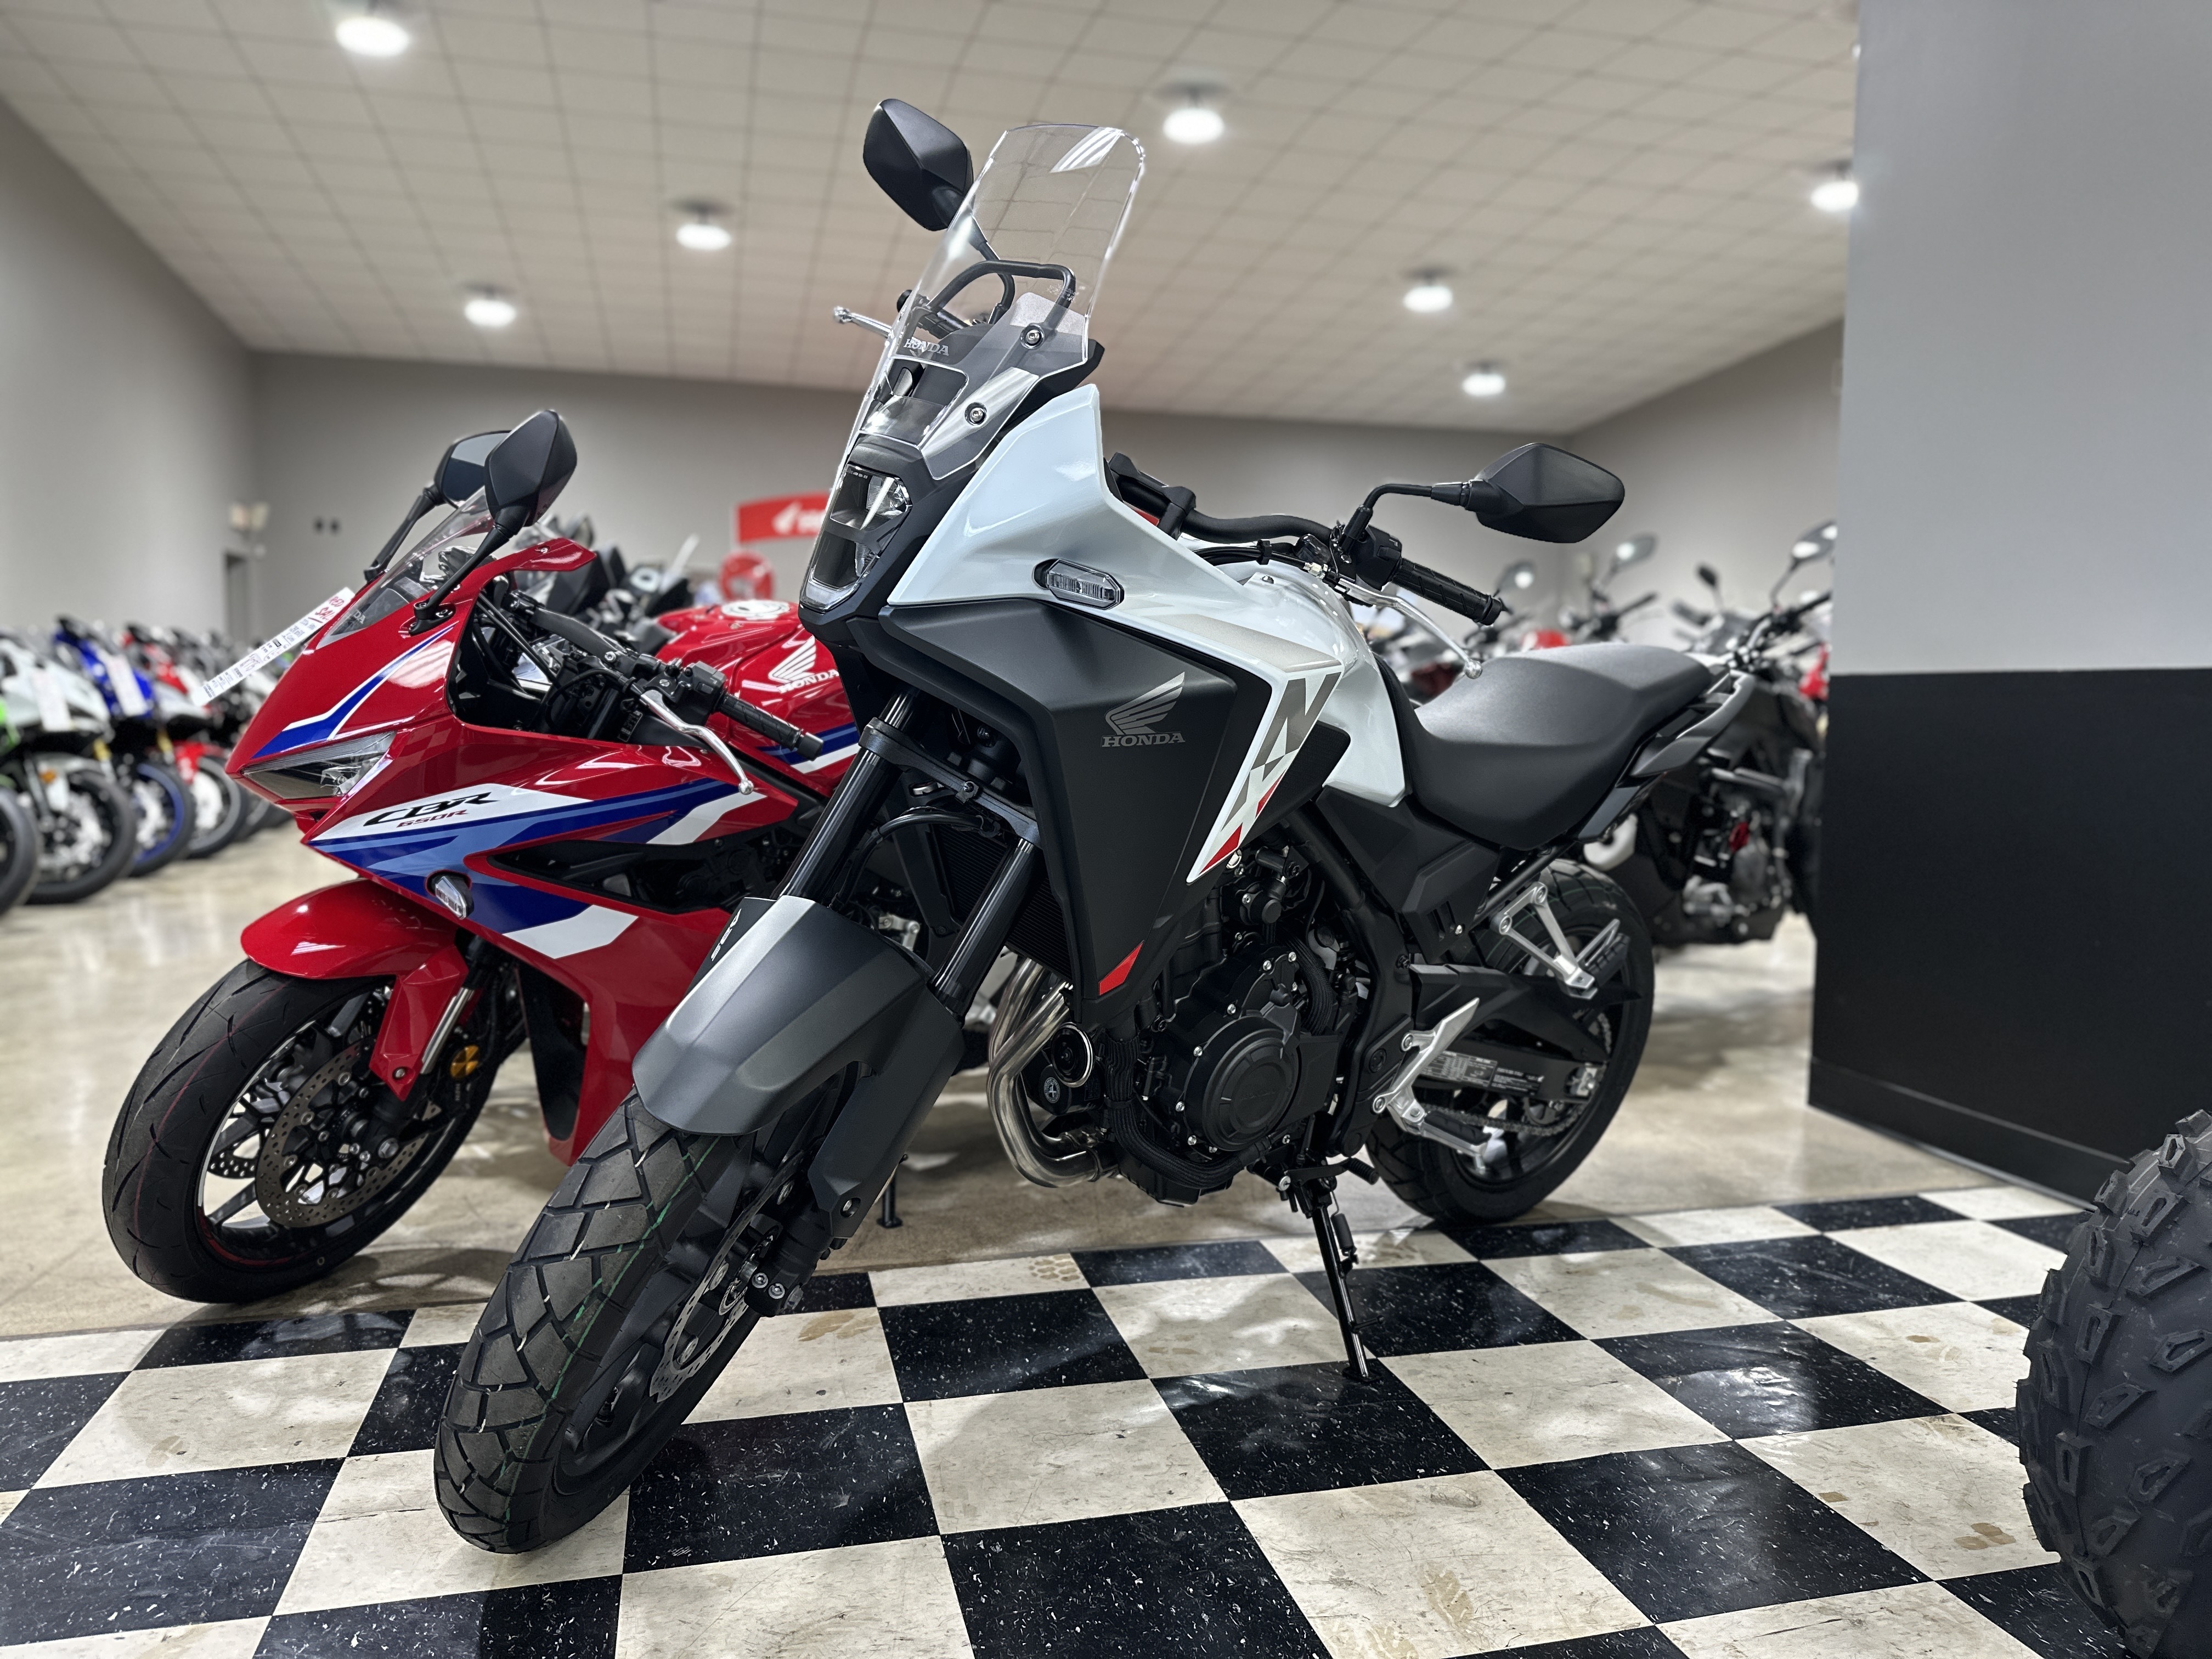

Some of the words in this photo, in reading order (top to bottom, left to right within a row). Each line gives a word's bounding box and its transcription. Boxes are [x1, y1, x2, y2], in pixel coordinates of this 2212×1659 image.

[903, 337, 949, 356] HONDA
[778, 669, 839, 694] HONDA
[1102, 732, 1186, 748] HONDA
[363, 792, 500, 827] CBR
[396, 809, 469, 828] 650R
